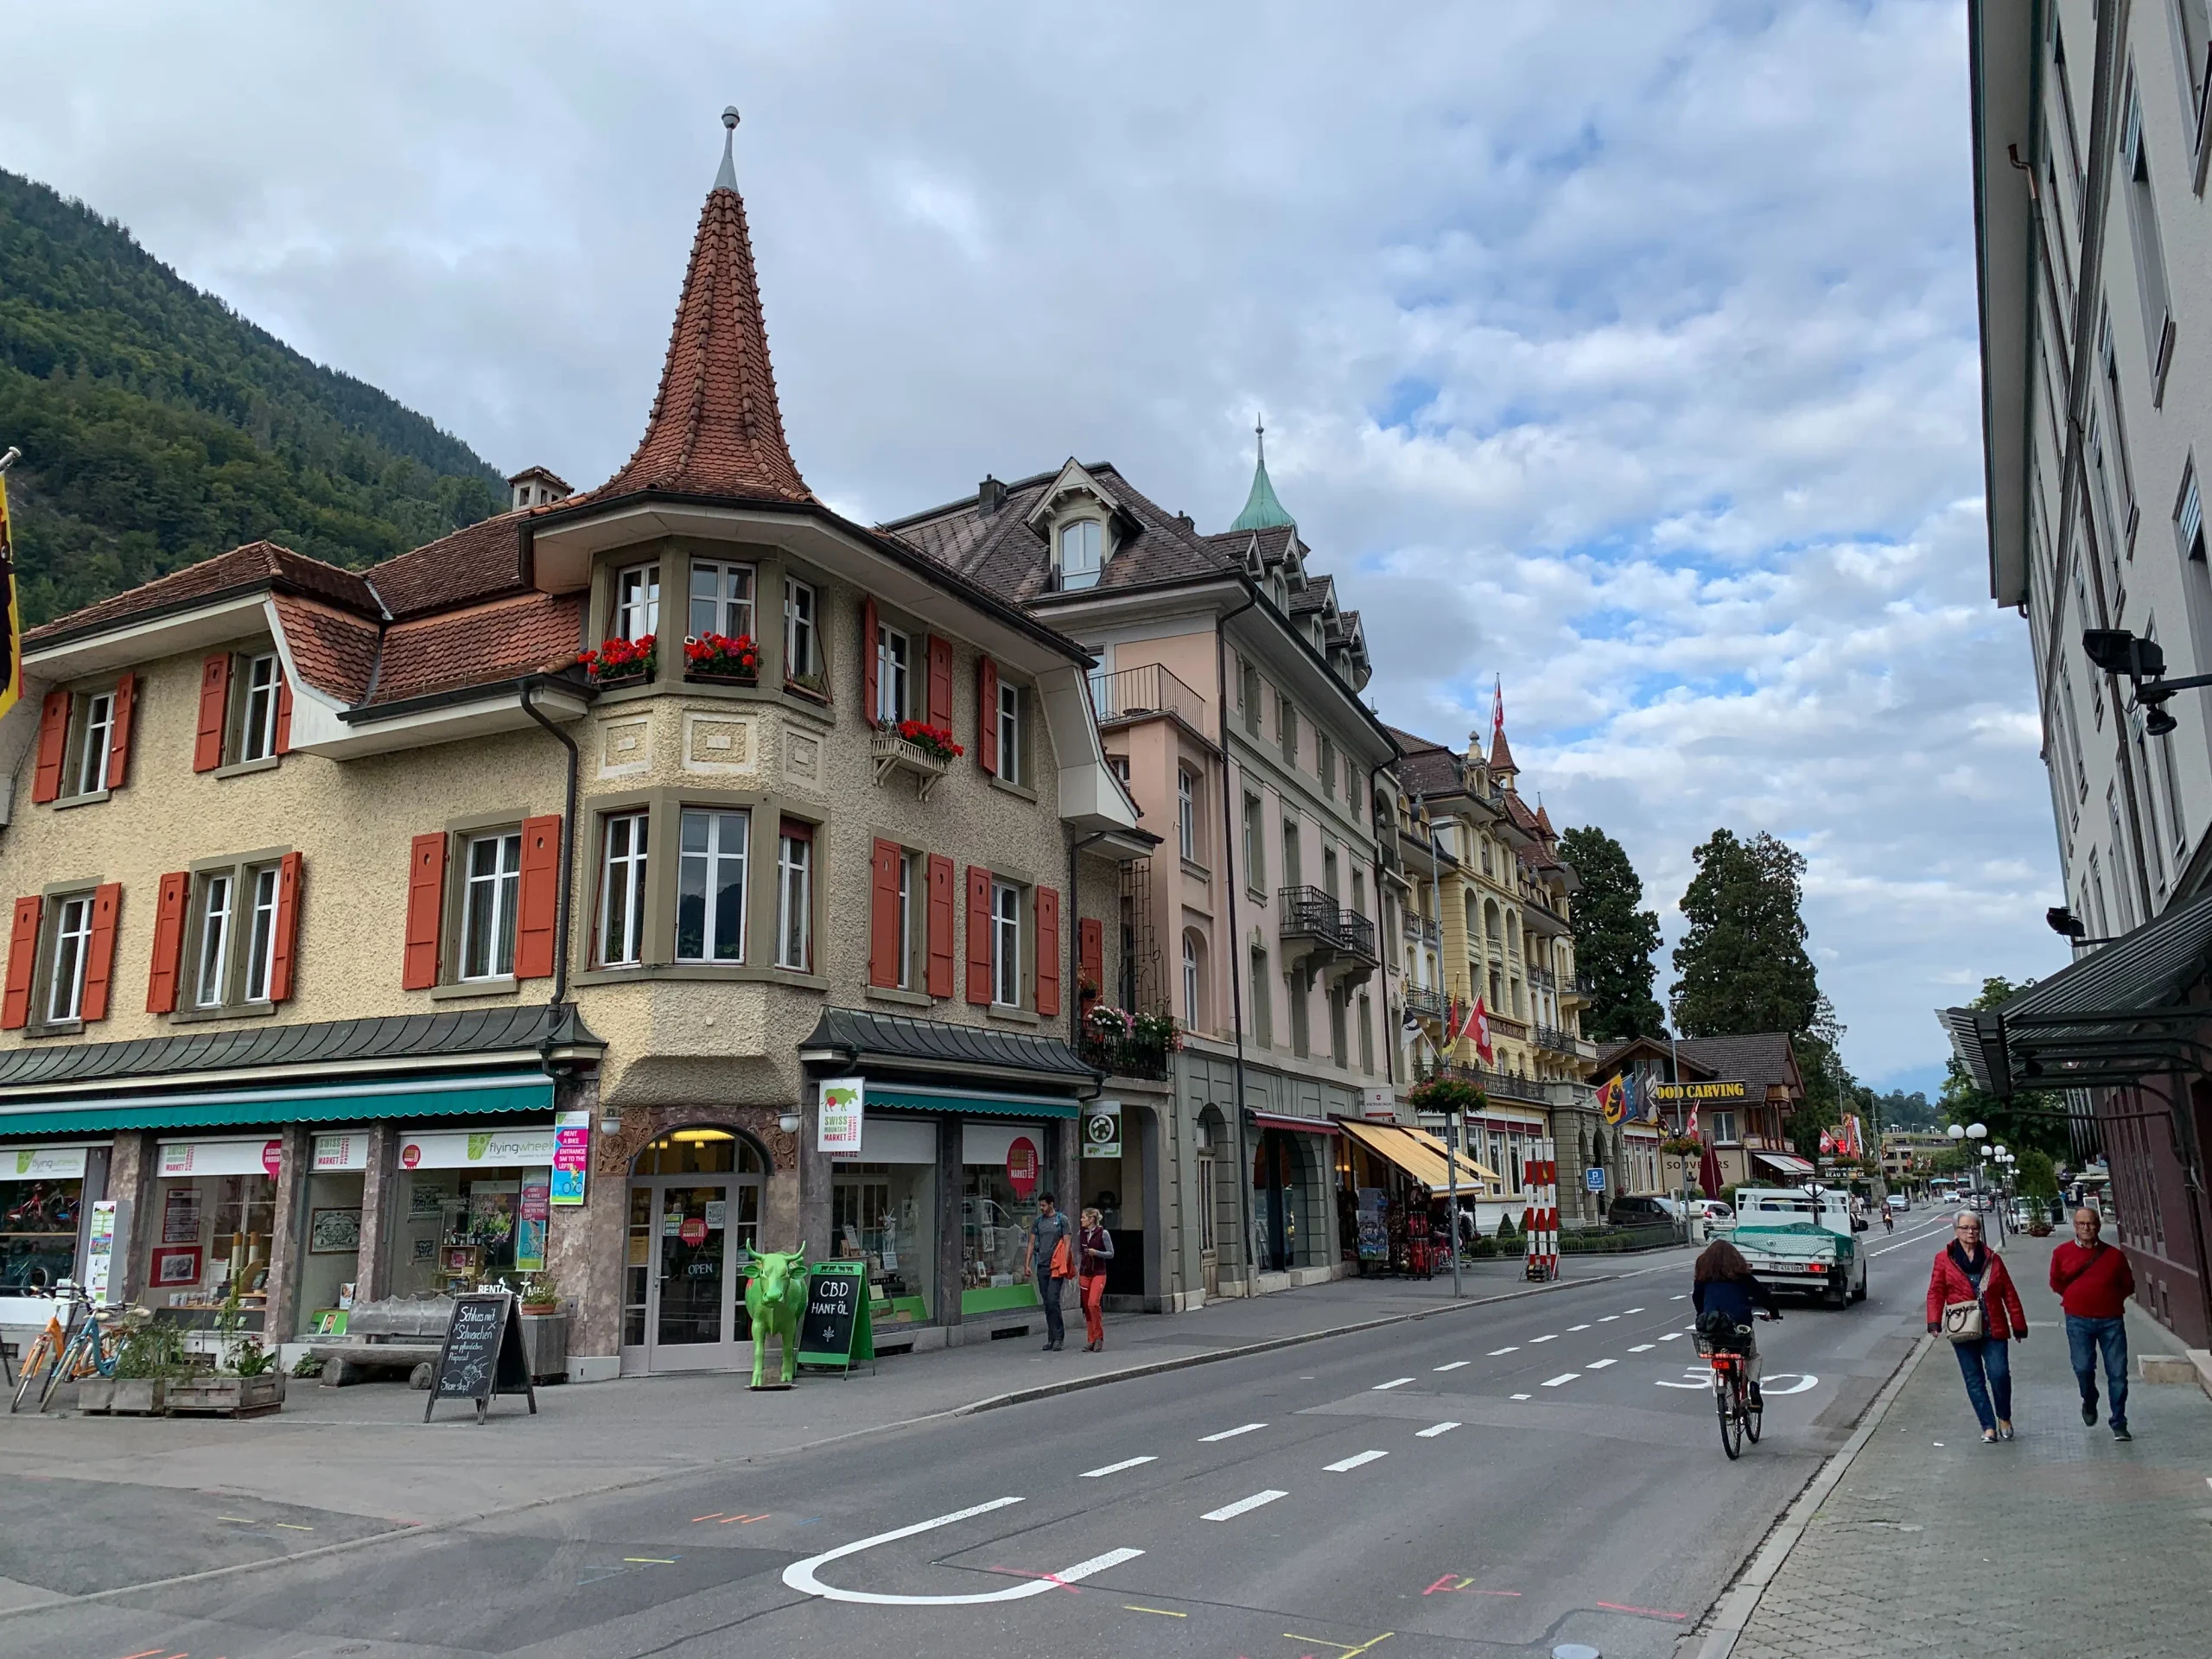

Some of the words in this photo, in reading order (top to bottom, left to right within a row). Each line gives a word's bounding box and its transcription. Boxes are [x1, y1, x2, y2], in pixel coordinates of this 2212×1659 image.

[1657, 1086, 1683, 1099] OOD
[1687, 1084, 1745, 1098] CARVING
[824, 1116, 848, 1126] SWISS
[318, 1156, 339, 1166] MARKET
[1667, 1160, 1729, 1170] SOUVERS
[166, 1163, 185, 1172] MARKET
[1011, 1169, 1027, 1179] MARKET
[688, 1263, 713, 1274] OPEN
[478, 1285, 501, 1294] RENT
[820, 1281, 849, 1297] CBD
[811, 1302, 836, 1314] HANF
[837, 1300, 849, 1315] ÖL
[459, 1306, 484, 1322] Schluss
[484, 1308, 496, 1321] mit
[456, 1324, 493, 1340] Schnarchen
